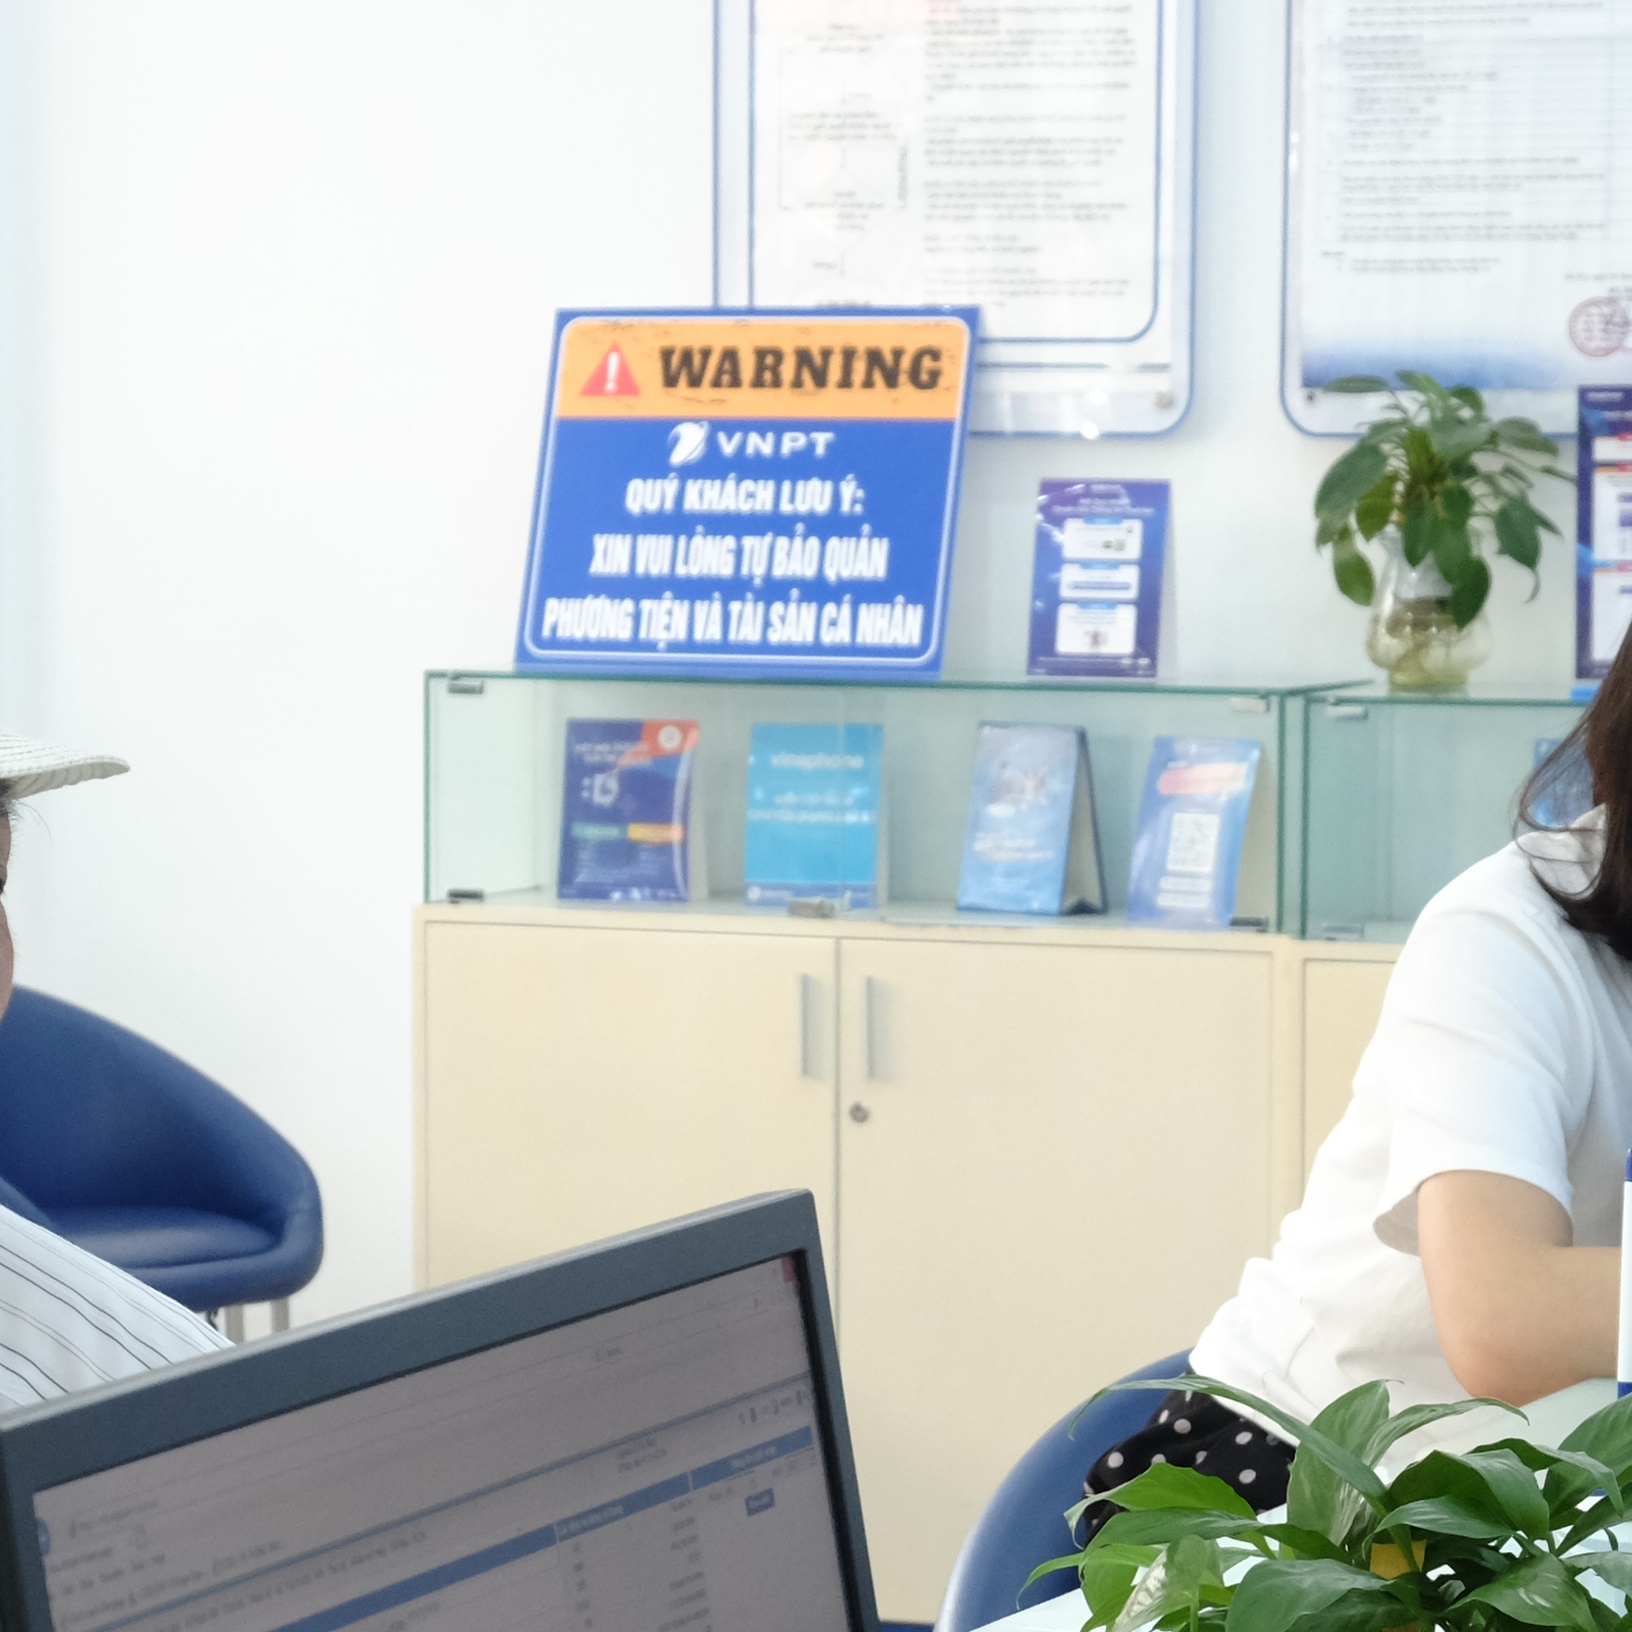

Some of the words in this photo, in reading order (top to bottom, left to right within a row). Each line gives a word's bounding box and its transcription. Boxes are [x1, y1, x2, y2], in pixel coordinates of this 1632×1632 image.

[659, 344, 945, 392] WARNING
[717, 430, 835, 459] VNPT
[625, 473, 677, 515] QUÝ
[682, 473, 774, 515] KHÁCH
[779, 478, 832, 515] LƯU
[838, 473, 865, 515] Ý:
[590, 533, 632, 577] XIN
[634, 534, 673, 578] VUI
[674, 526, 736, 579] LÒNG
[740, 529, 772, 587] TỰ
[773, 524, 819, 580] BẢO
[824, 524, 889, 581] QUẢN
[542, 594, 634, 642] PHƯƠNG
[638, 591, 688, 650] TIỆN
[692, 592, 724, 642] VÀ
[728, 593, 764, 643] TÀI
[768, 593, 818, 644] SẢN
[820, 596, 856, 646] CÁ
[857, 596, 924, 647] NHÂN
